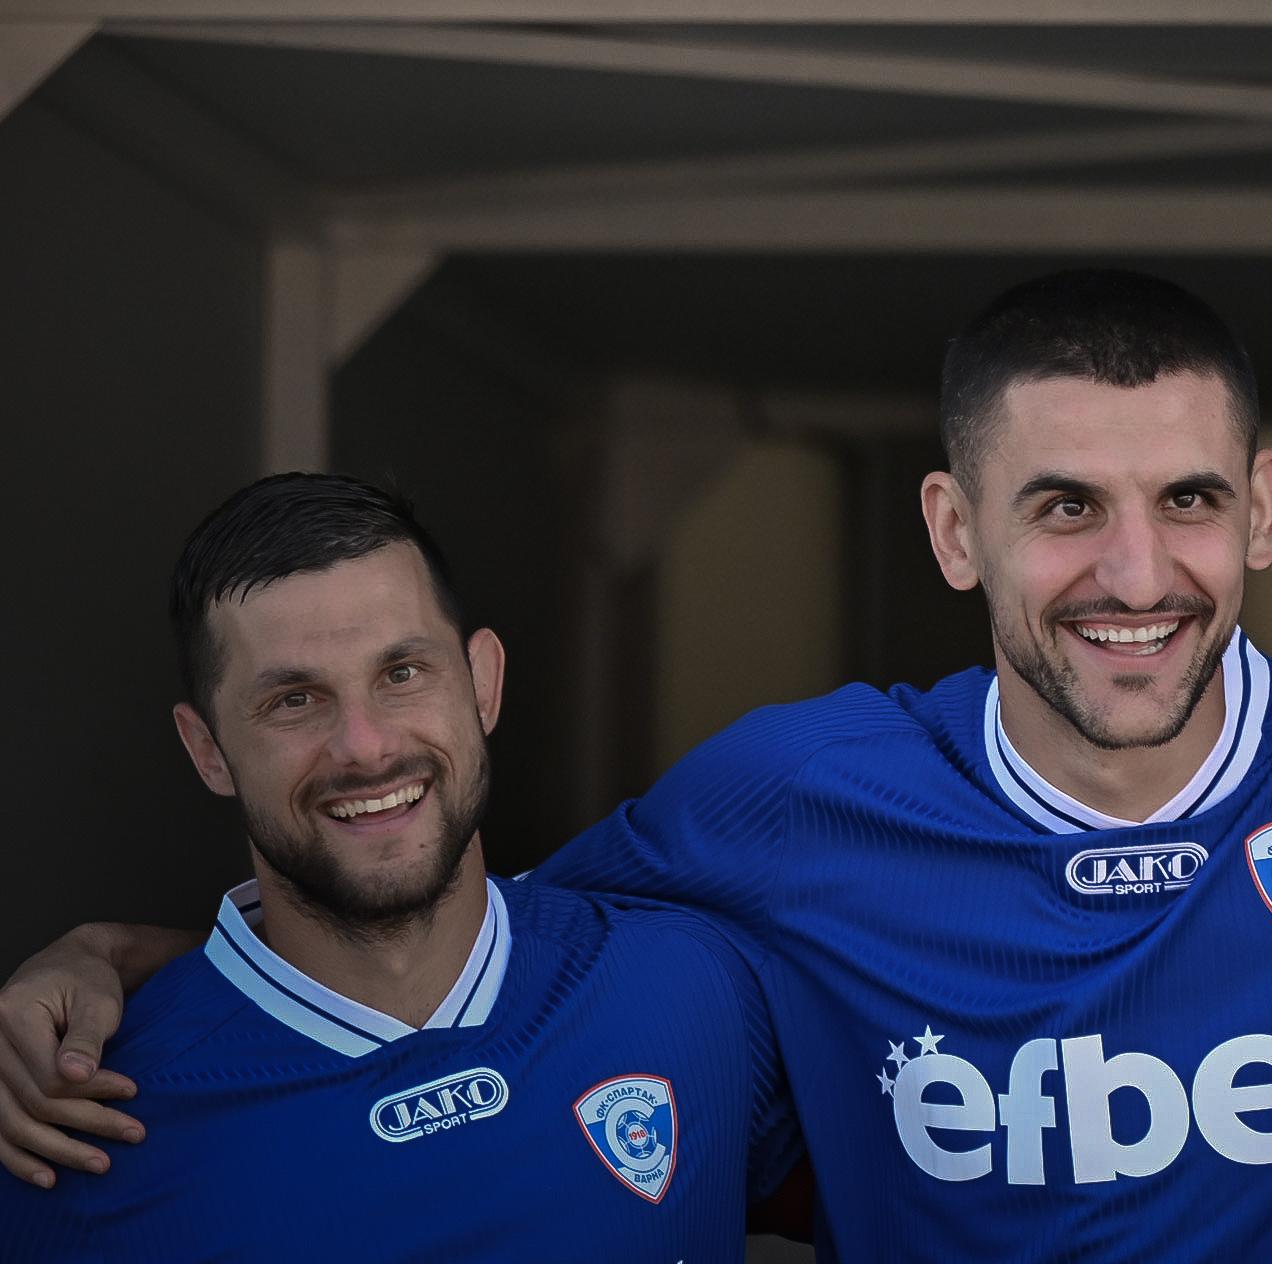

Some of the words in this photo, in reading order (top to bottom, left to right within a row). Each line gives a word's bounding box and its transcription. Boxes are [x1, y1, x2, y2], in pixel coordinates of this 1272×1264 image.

[1082, 852, 1199, 884] JAKO
[1114, 882, 1162, 895] SPORT
[387, 1077, 497, 1131] JAKO
[423, 1112, 468, 1136] SPORT
[628, 1129, 647, 1141] 1918
[633, 1167, 665, 1184] ВАРНА
